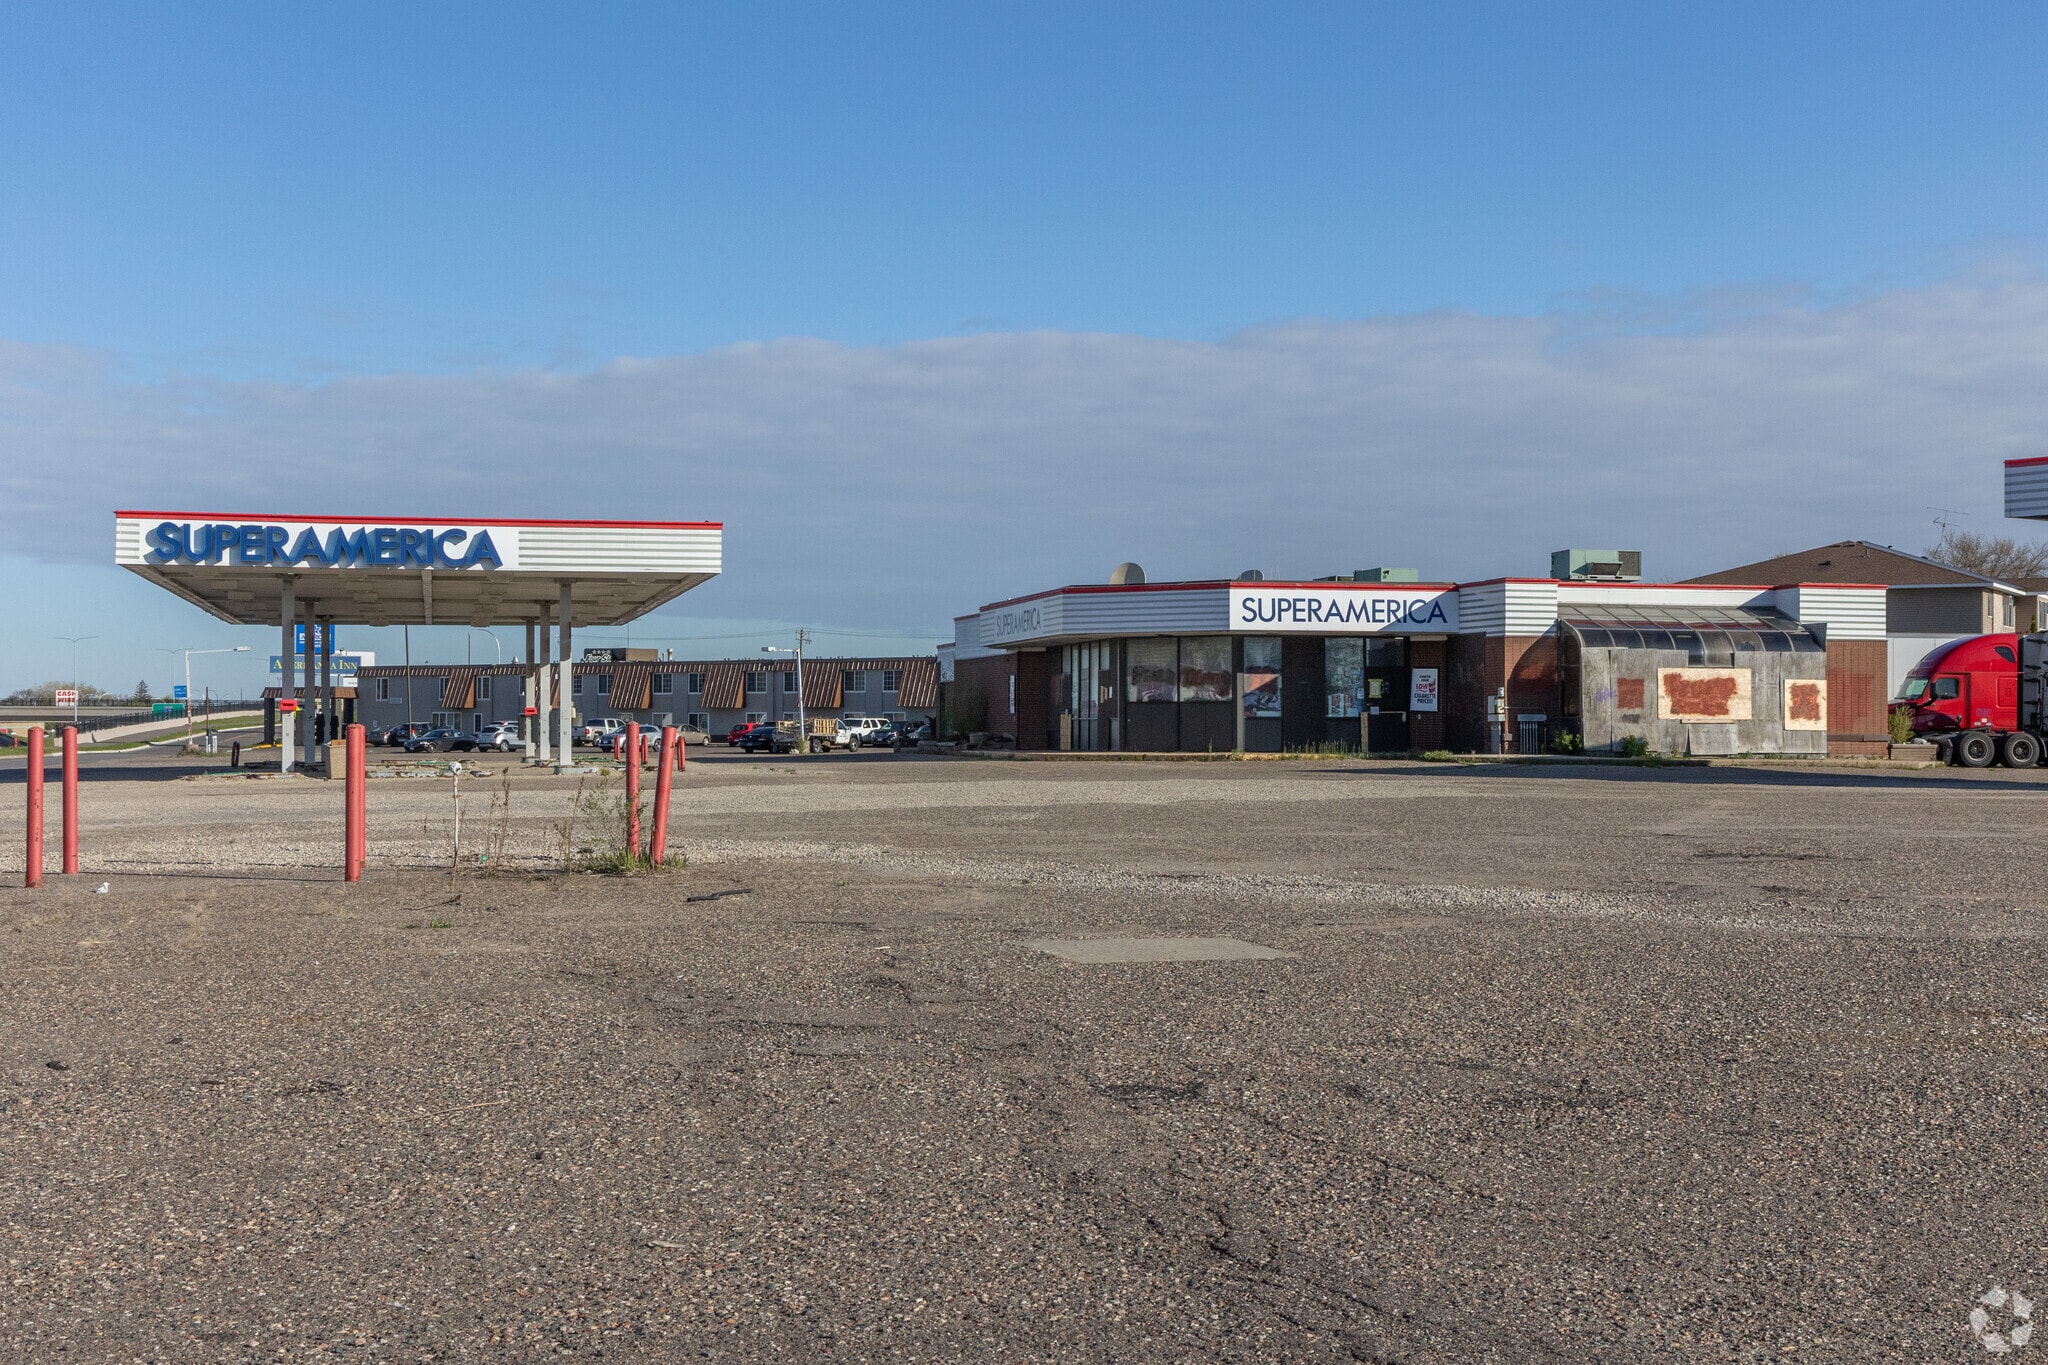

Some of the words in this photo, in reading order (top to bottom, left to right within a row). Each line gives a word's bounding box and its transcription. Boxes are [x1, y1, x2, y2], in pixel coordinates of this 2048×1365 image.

[145, 521, 503, 567] SUPERAMERICA
[996, 607, 1042, 637] SUPERAMERICA
[1241, 597, 1448, 624] SUPERAMERICA
